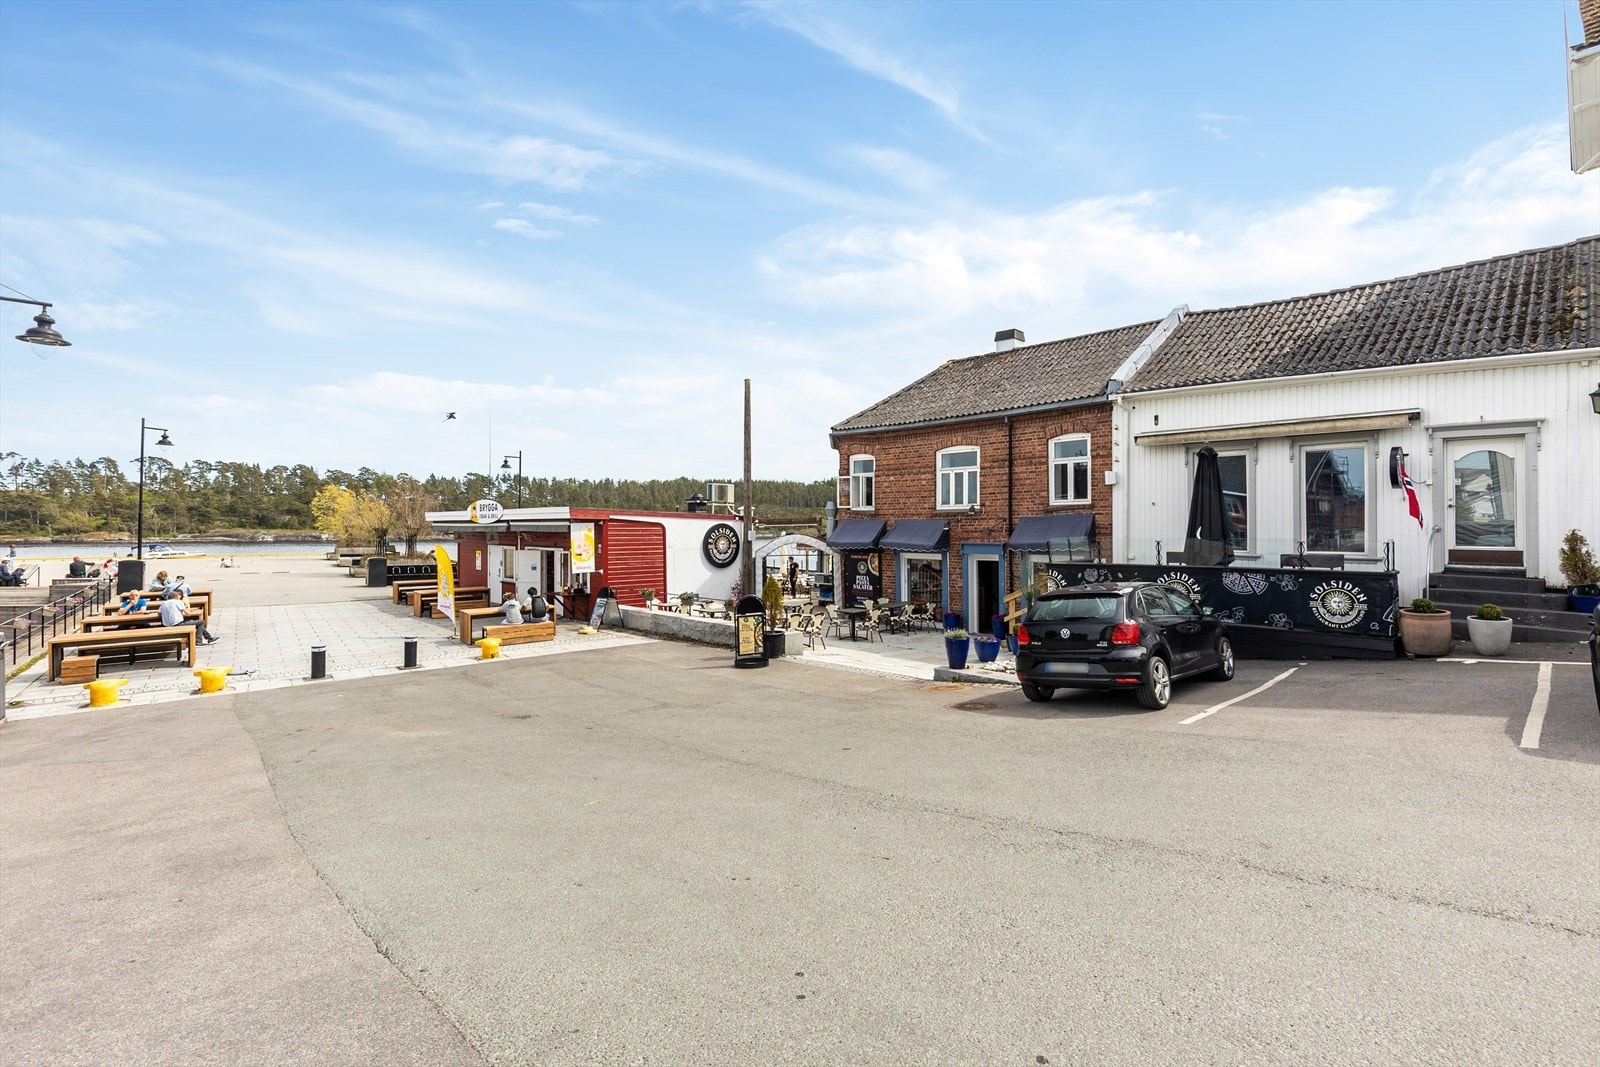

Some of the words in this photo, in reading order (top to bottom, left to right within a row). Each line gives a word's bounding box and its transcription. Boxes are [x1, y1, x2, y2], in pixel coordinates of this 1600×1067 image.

[479, 503, 499, 512] BRYGGA
[708, 527, 737, 544] SOLSIDEN
[1157, 571, 1201, 592] OLSIDEN
[1310, 580, 1367, 602] SOLSIDEN
[1312, 607, 1339, 628] RESTAURANT
